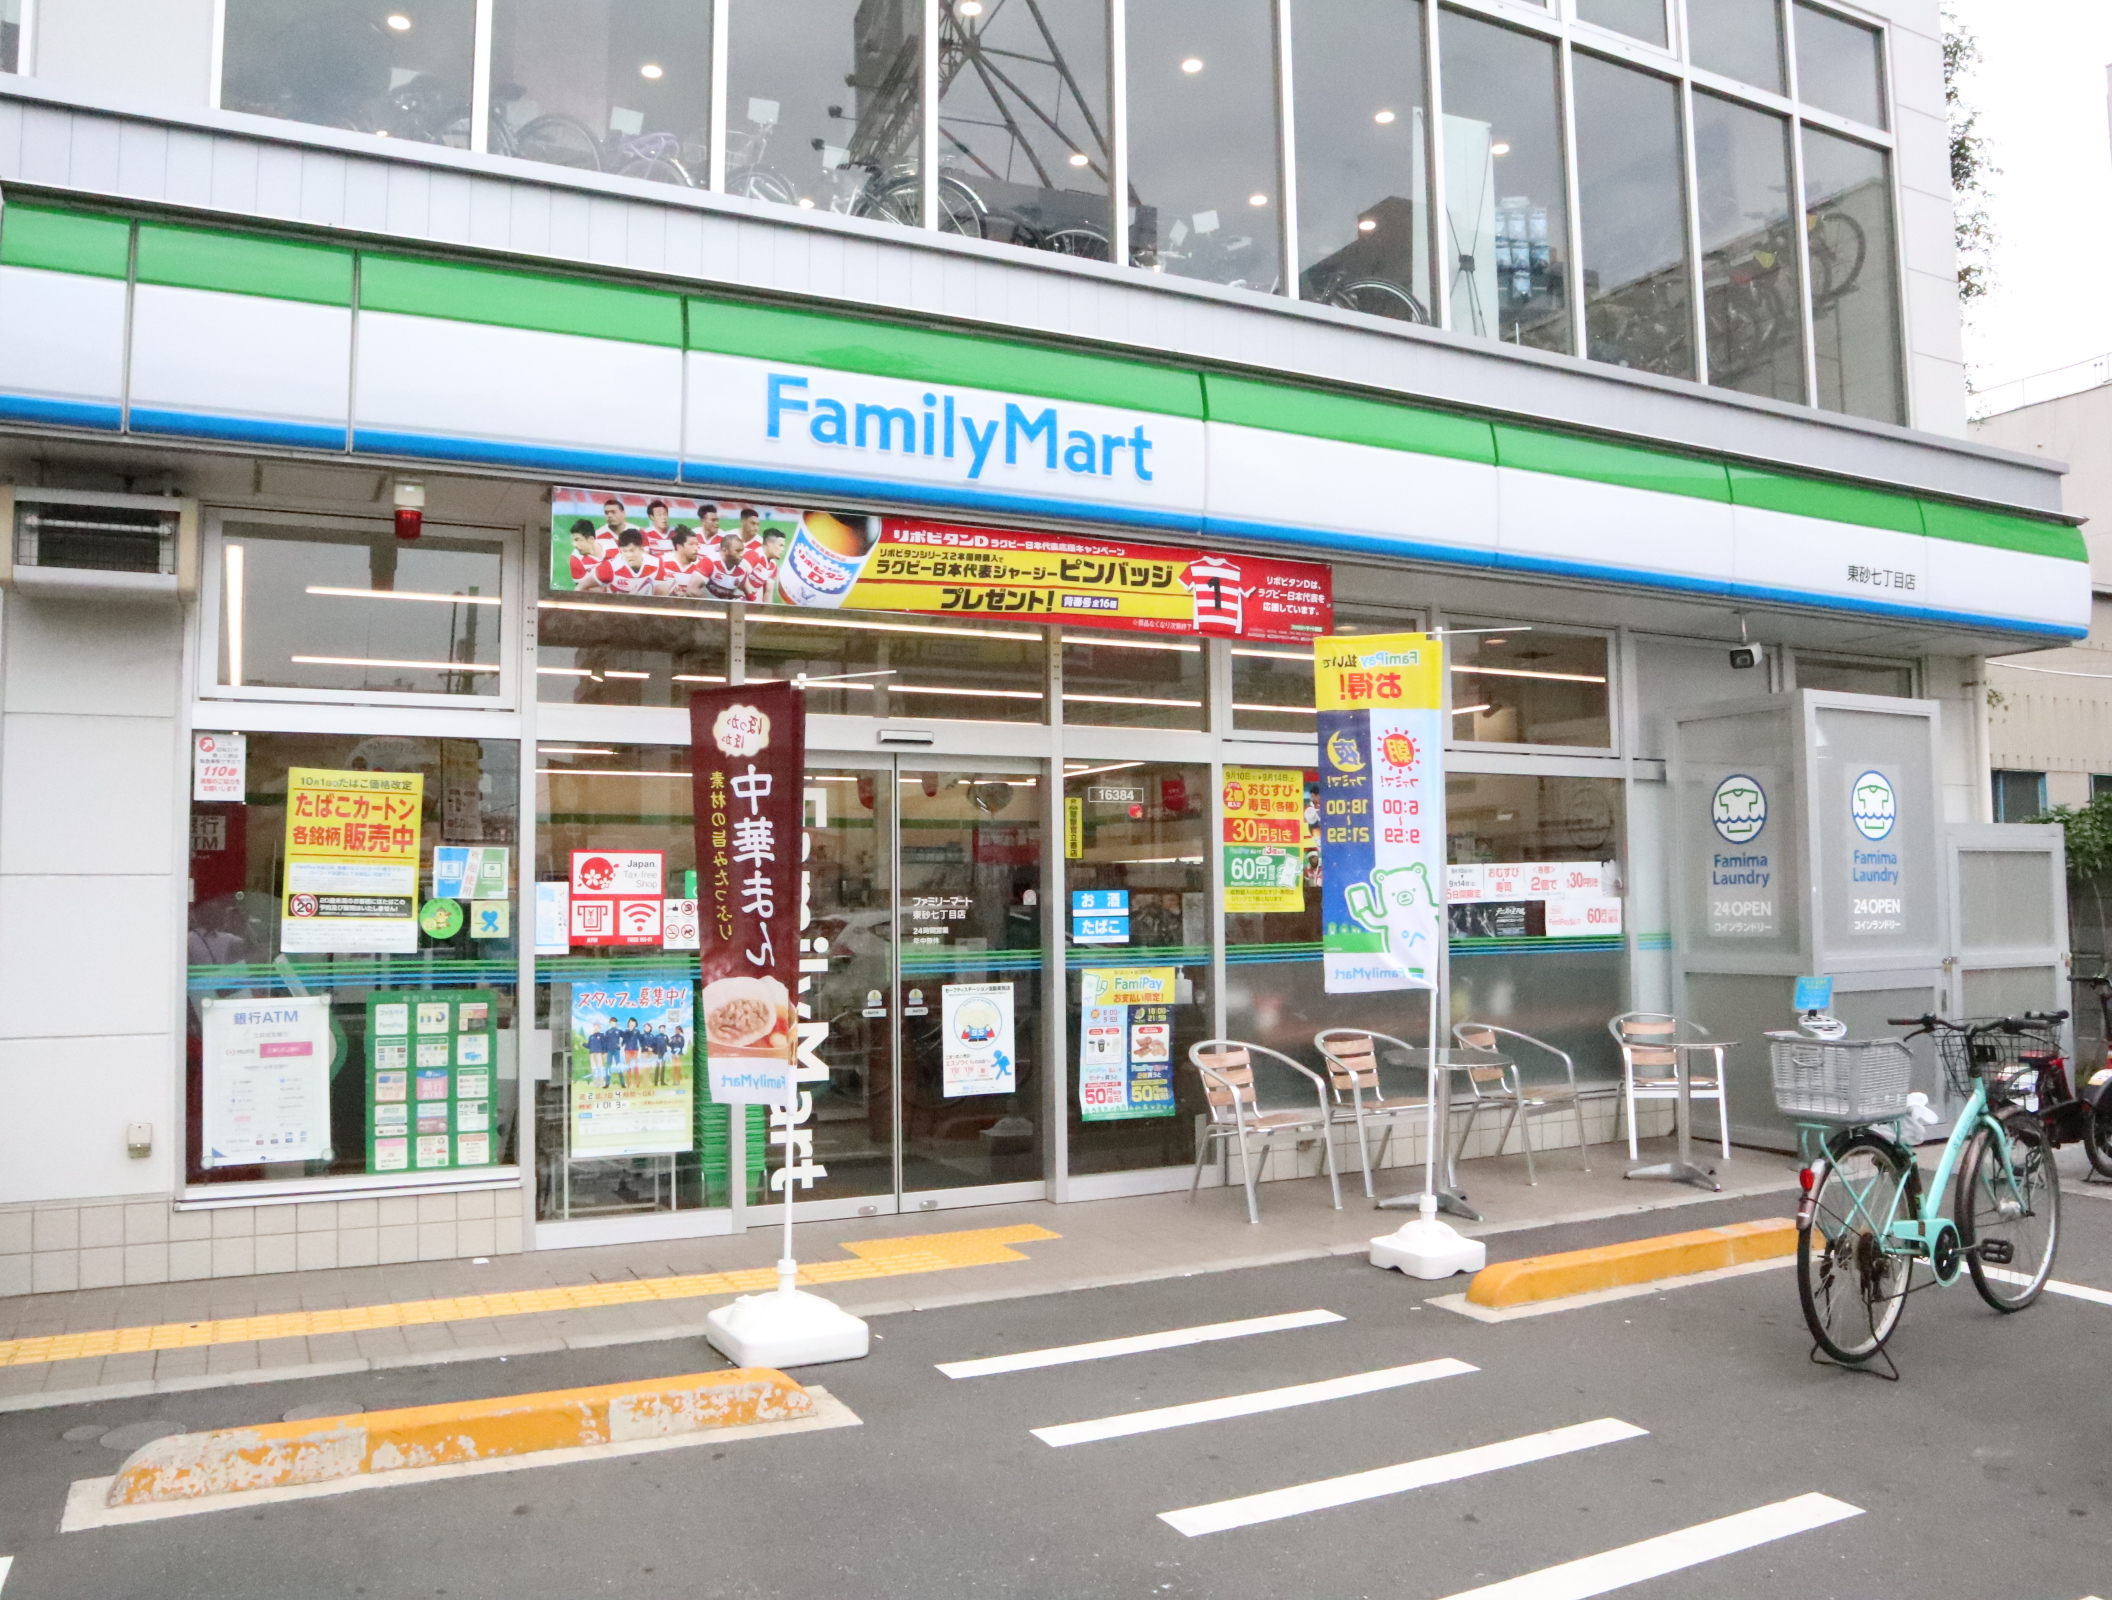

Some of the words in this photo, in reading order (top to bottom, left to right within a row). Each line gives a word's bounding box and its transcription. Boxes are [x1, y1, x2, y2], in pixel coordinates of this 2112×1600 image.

[767, 373, 1153, 481] FamilyMart
[893, 529, 989, 548] リポビタンD
[1846, 564, 1916, 591] 東砂七丁目店
[1207, 577, 1221, 610] 1
[301, 777, 413, 791] 10月1日たばこ価格改定
[1098, 789, 1134, 801] 16384
[294, 792, 416, 821] たばこカートン
[1714, 853, 1768, 868] Famima
[1854, 850, 1898, 865] Famima
[624, 871, 657, 879] Tax-free
[1713, 870, 1770, 888] Laundry
[1853, 867, 1899, 886] Laundry
[636, 880, 657, 888] Shop
[912, 896, 973, 907] ファミリーマート
[912, 909, 966, 920] 東砂七丁目店
[1082, 919, 1120, 934] たばこ
[1714, 922, 1772, 932] コインランドリー
[1854, 920, 1900, 930] コインランドリー
[1114, 977, 1162, 991] FamiPay
[578, 987, 687, 1008] スタッフさん募集中!
[233, 1010, 299, 1025] 銀行ATM
